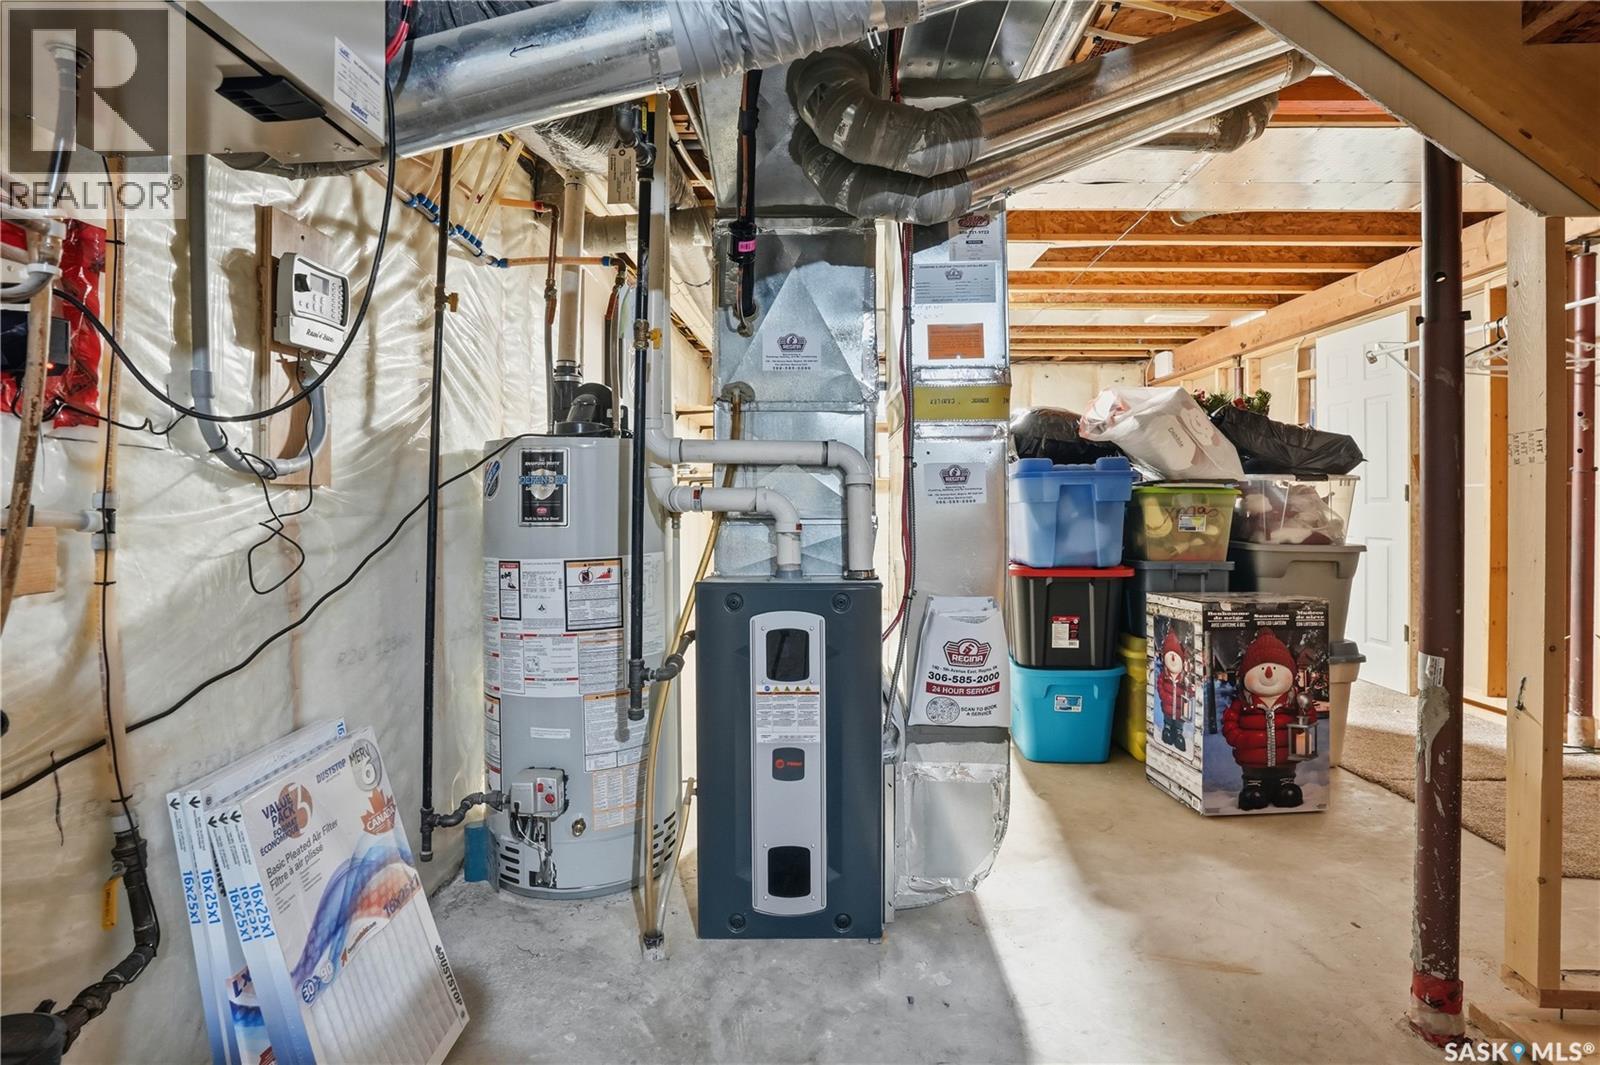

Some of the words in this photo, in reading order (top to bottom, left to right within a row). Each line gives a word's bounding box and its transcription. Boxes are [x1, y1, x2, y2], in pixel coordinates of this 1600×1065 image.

[951, 654, 983, 663] REGINA
[928, 671, 1000, 684] 306-585-2000
[932, 685, 941, 693] 24
[942, 687, 966, 695] HOUR
[966, 685, 996, 695] SERVICE
[348, 744, 371, 767] MERV
[316, 758, 347, 784] DUSTSTOP
[261, 793, 293, 819] VALUE
[271, 804, 296, 828] PACK
[273, 816, 298, 838] FORMAT
[266, 858, 286, 879] Basic
[285, 840, 312, 864] Pleated
[312, 831, 323, 844] Air
[322, 820, 338, 837] Filter
[270, 869, 289, 891] Filtre
[183, 870, 201, 924] 16x25x1
[201, 869, 220, 924] 16x25x1
[229, 888, 252, 942] 16x25x1
[250, 883, 275, 938] 16x25x1
[302, 982, 315, 999] 30
[437, 952, 463, 1006] DUSTSTOP
